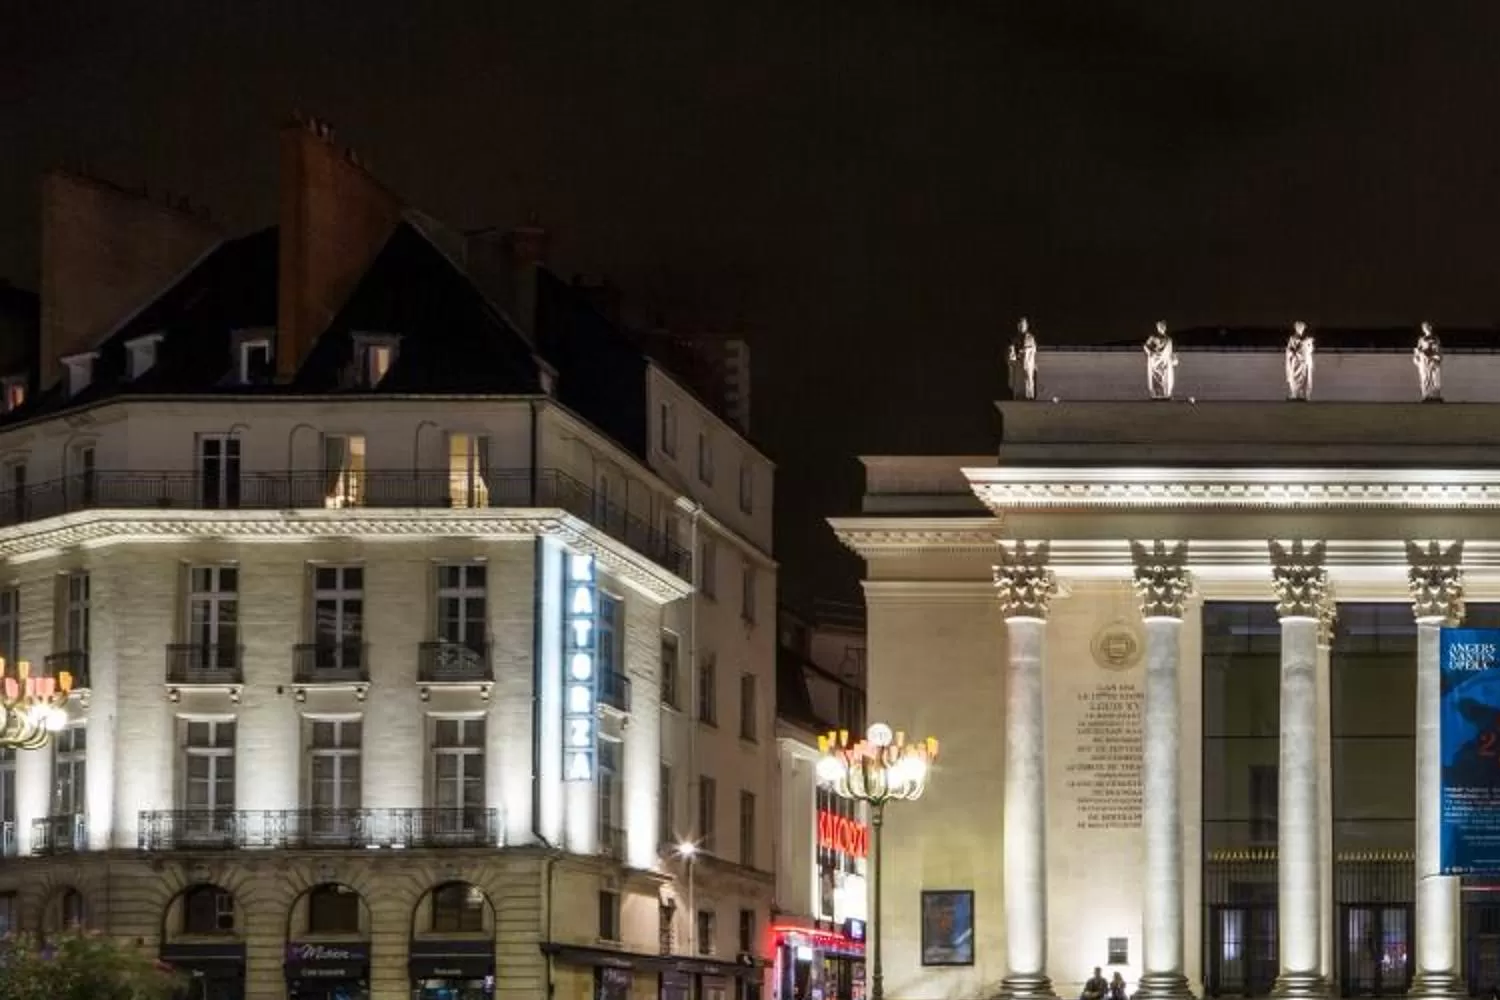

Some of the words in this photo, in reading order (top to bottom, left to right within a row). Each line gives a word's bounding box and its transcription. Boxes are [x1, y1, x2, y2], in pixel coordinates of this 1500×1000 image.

[1449, 642, 1496, 653] ANGERS
[1449, 651, 1495, 661] NANTES
[571, 555, 593, 780] KATORZA
